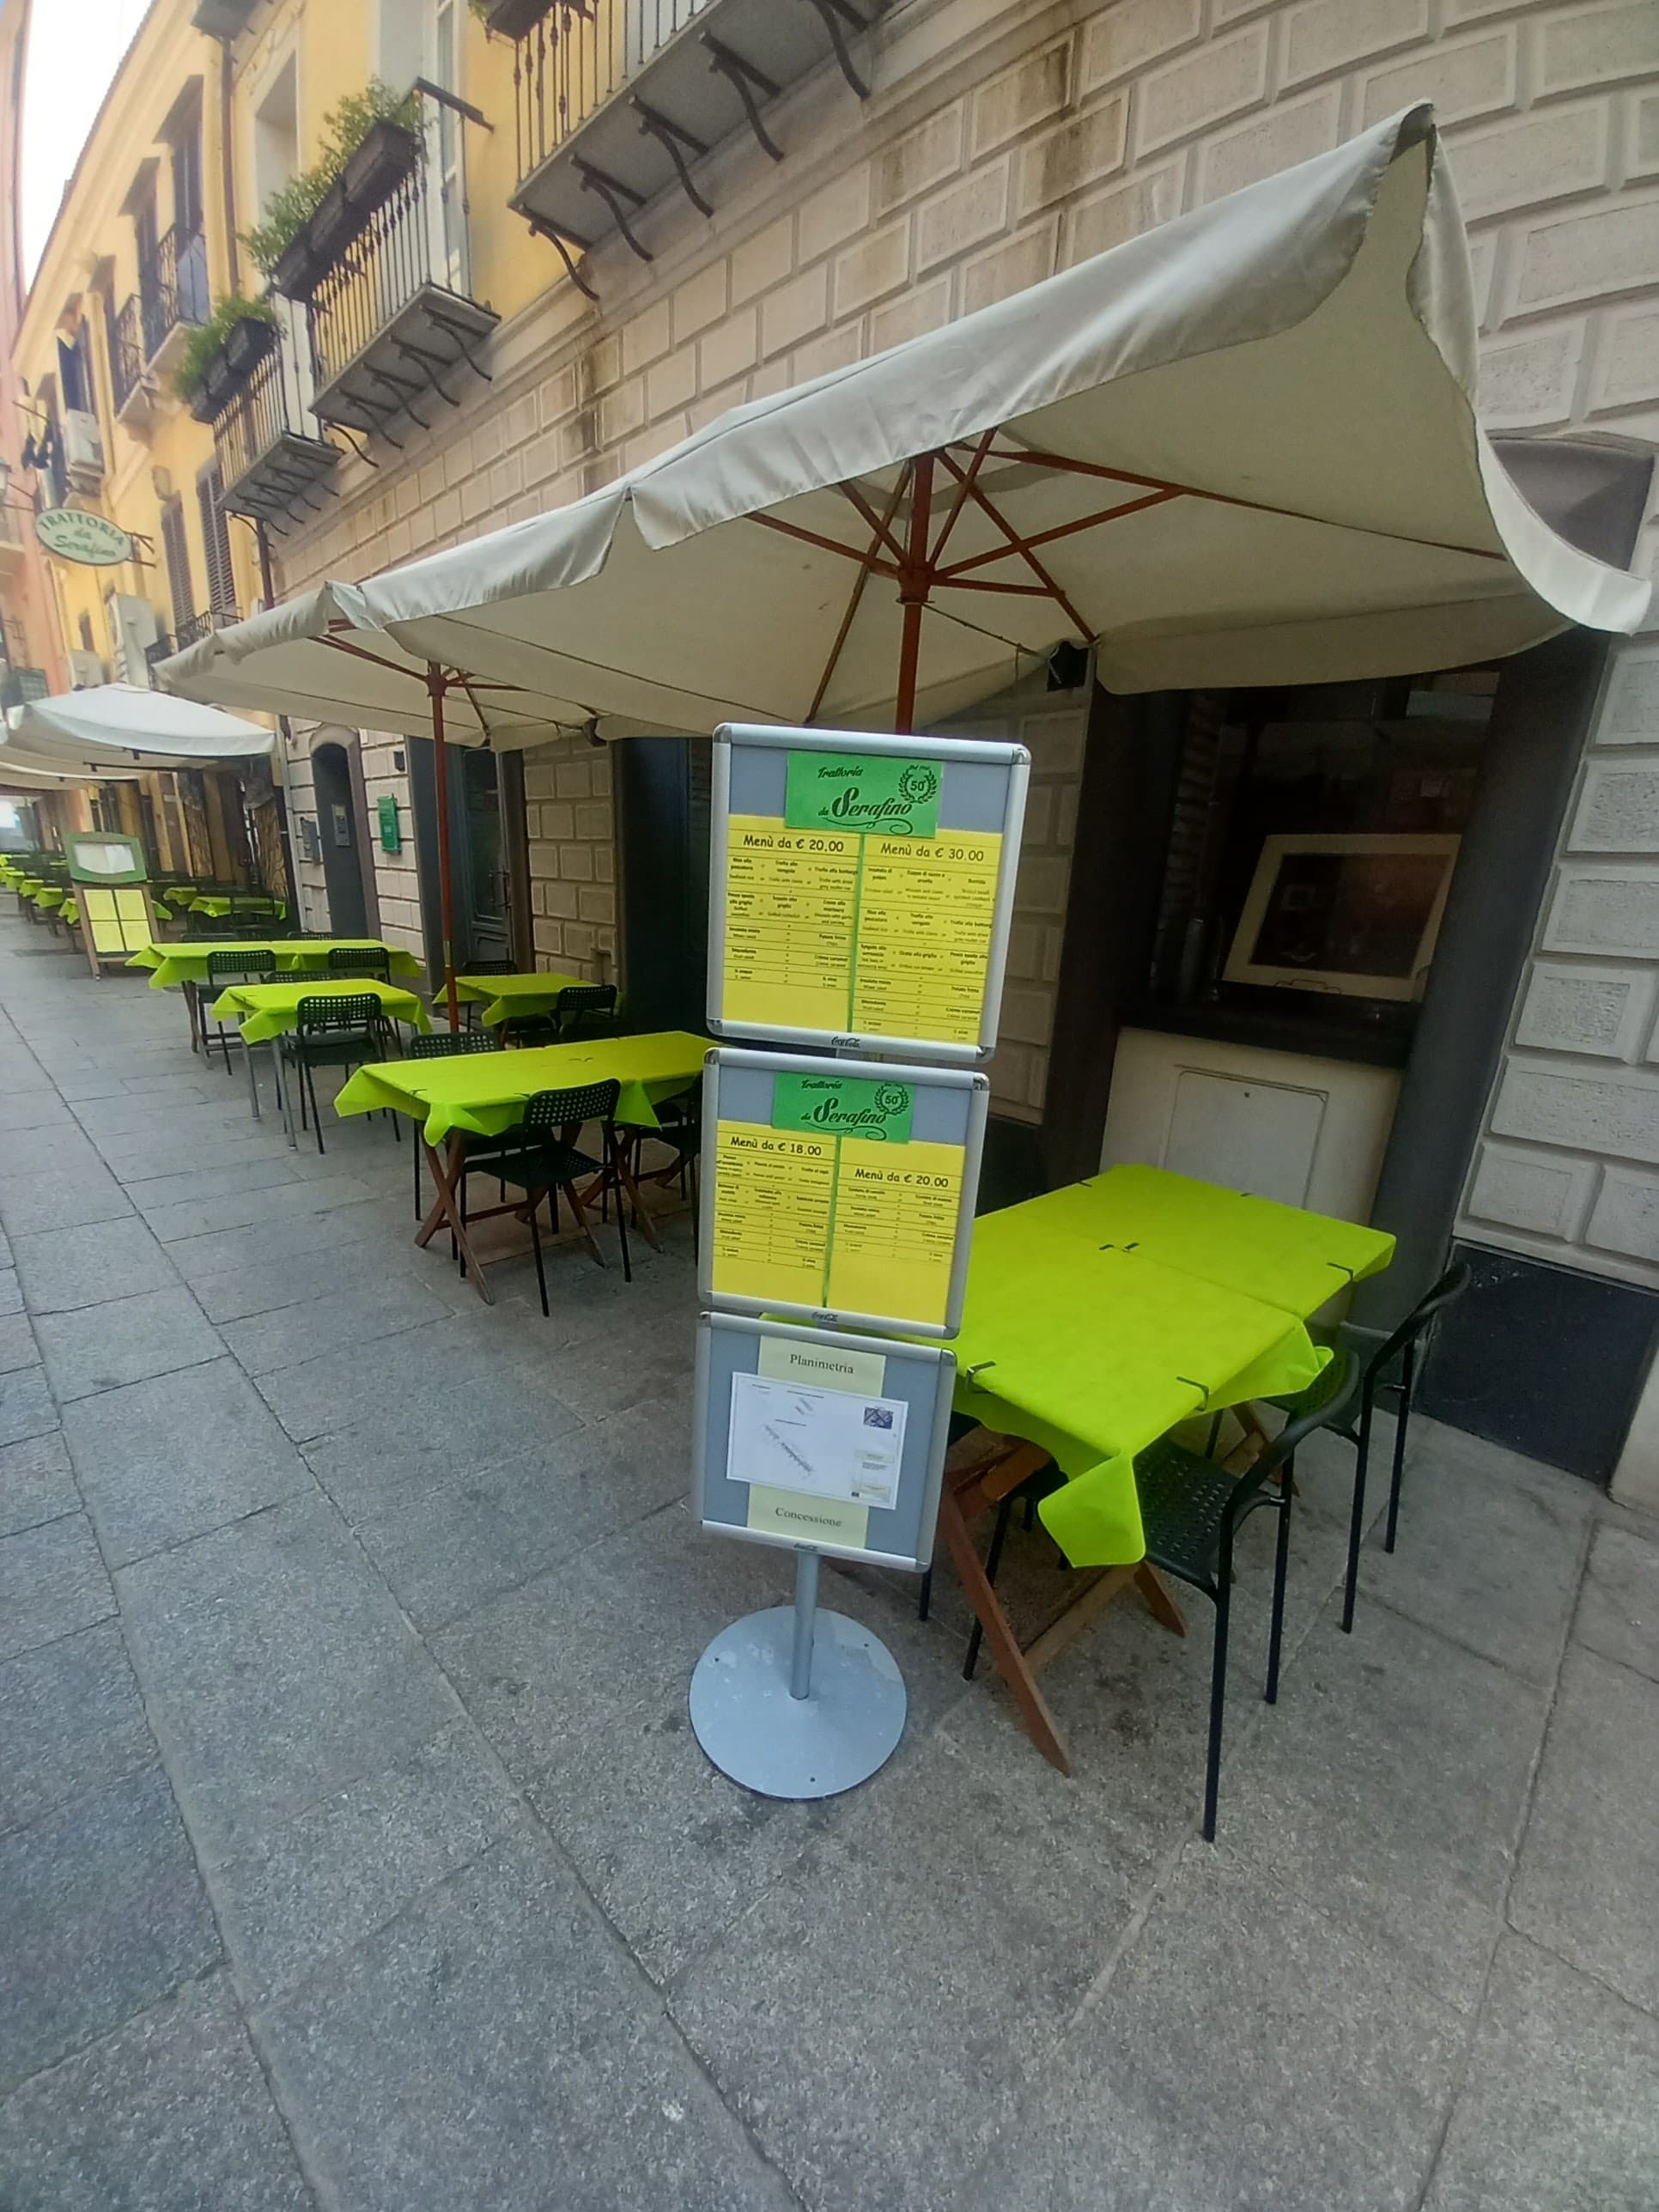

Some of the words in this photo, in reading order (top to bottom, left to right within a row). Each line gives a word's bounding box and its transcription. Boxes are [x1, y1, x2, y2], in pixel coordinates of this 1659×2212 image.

[40, 513, 125, 545] TRATTORIA
[817, 765, 864, 779] Trattoria
[817, 806, 830, 817] da
[831, 787, 912, 819] Serafino
[744, 834, 774, 848] Menù
[778, 836, 792, 849] da
[796, 838, 805, 850] €
[809, 839, 844, 853] 20.00
[880, 842, 911, 856] Menù
[916, 845, 930, 858] da
[935, 847, 944, 858] €
[948, 848, 984, 862] 30.00
[800, 1111, 811, 1121] da
[813, 1097, 887, 1125] Serafino
[731, 1136, 757, 1148] Menù
[762, 1139, 774, 1151] da
[778, 1142, 786, 1152] €
[790, 1143, 822, 1156] 18.00
[854, 1169, 883, 1181] Menù
[887, 1171, 900, 1182] da
[904, 1174, 913, 1183] €
[916, 1175, 948, 1188] 20.00
[790, 1353, 854, 1374] Planimetria
[775, 1507, 842, 1527] Concessione
